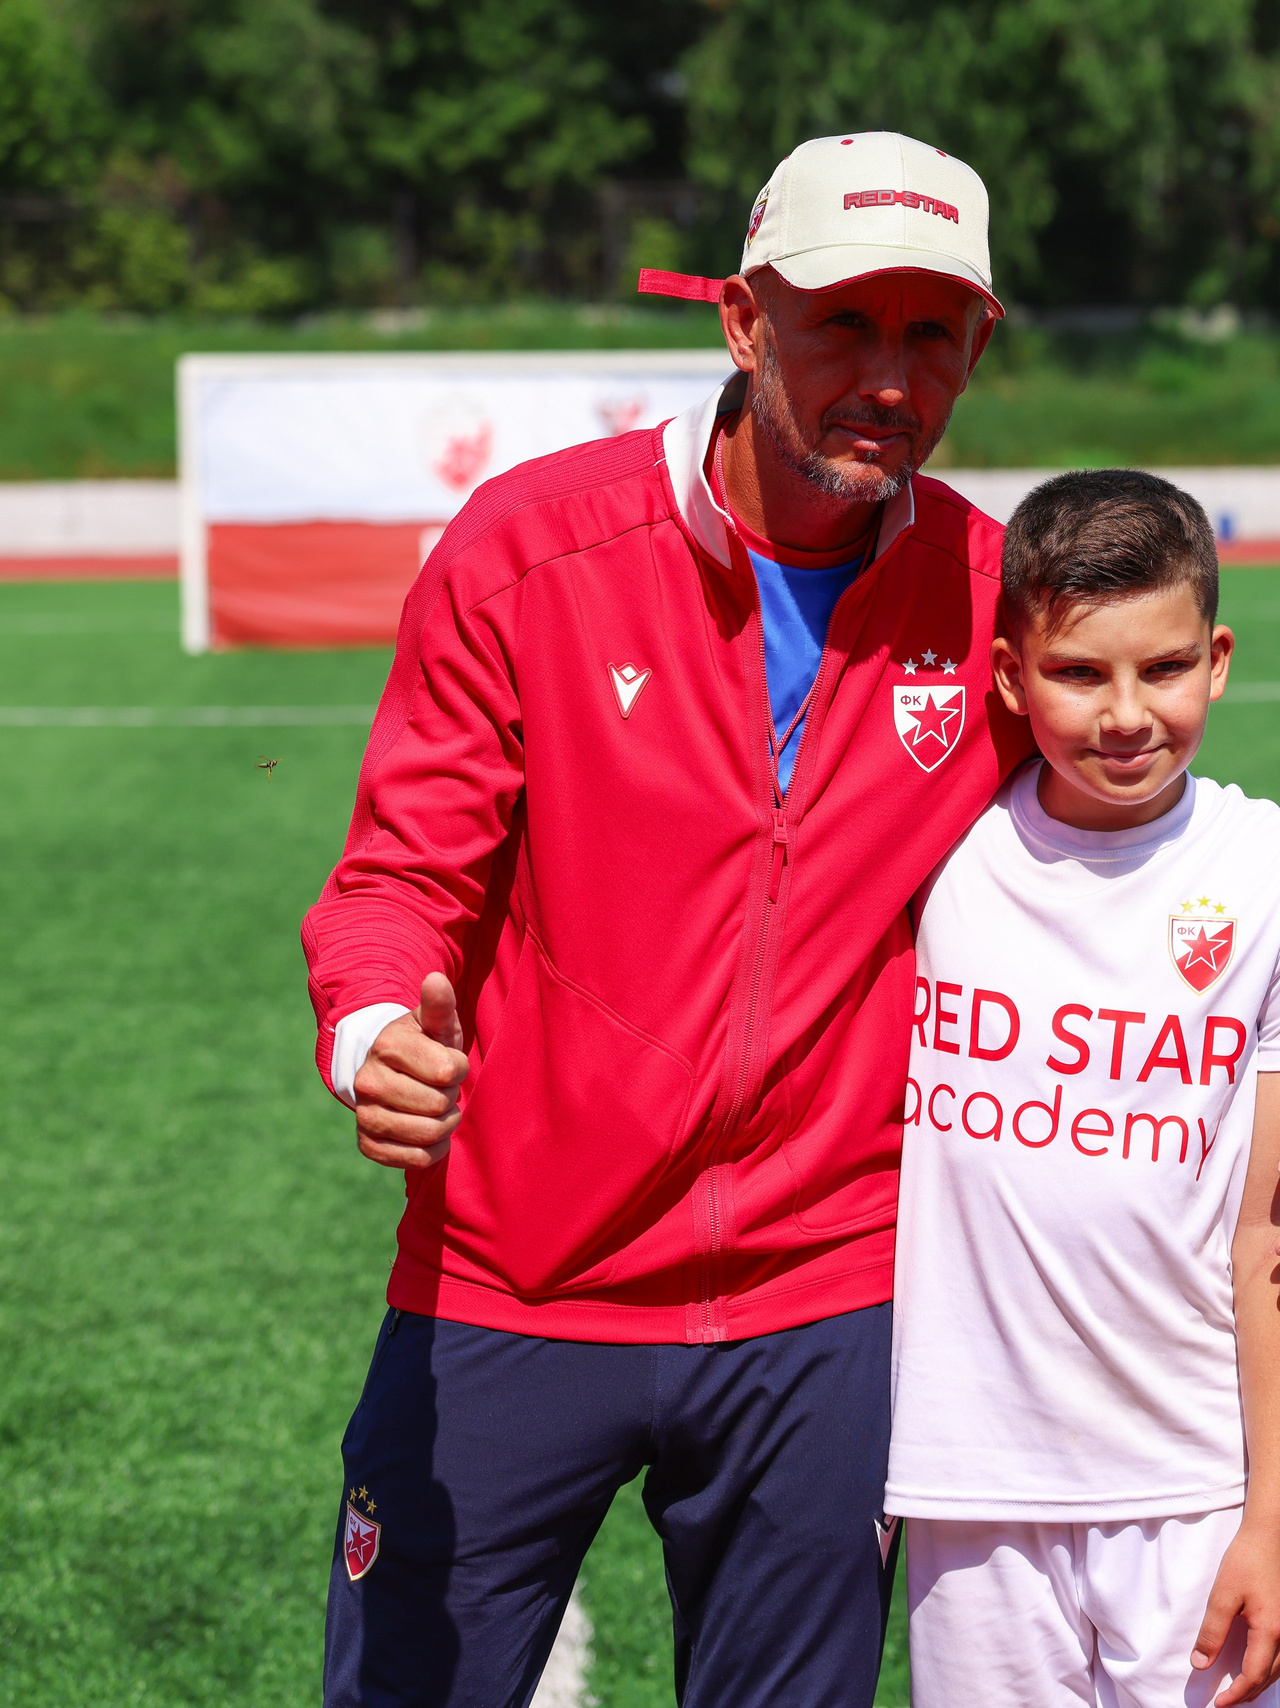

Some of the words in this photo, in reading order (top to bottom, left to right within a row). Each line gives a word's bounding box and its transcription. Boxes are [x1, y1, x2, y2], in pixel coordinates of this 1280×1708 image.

[843, 189, 896, 210] RED
[902, 190, 959, 224] STAR
[912, 975, 1020, 1061] RED
[1046, 1003, 1247, 1086] STAR
[903, 1077, 1222, 1182] academy
